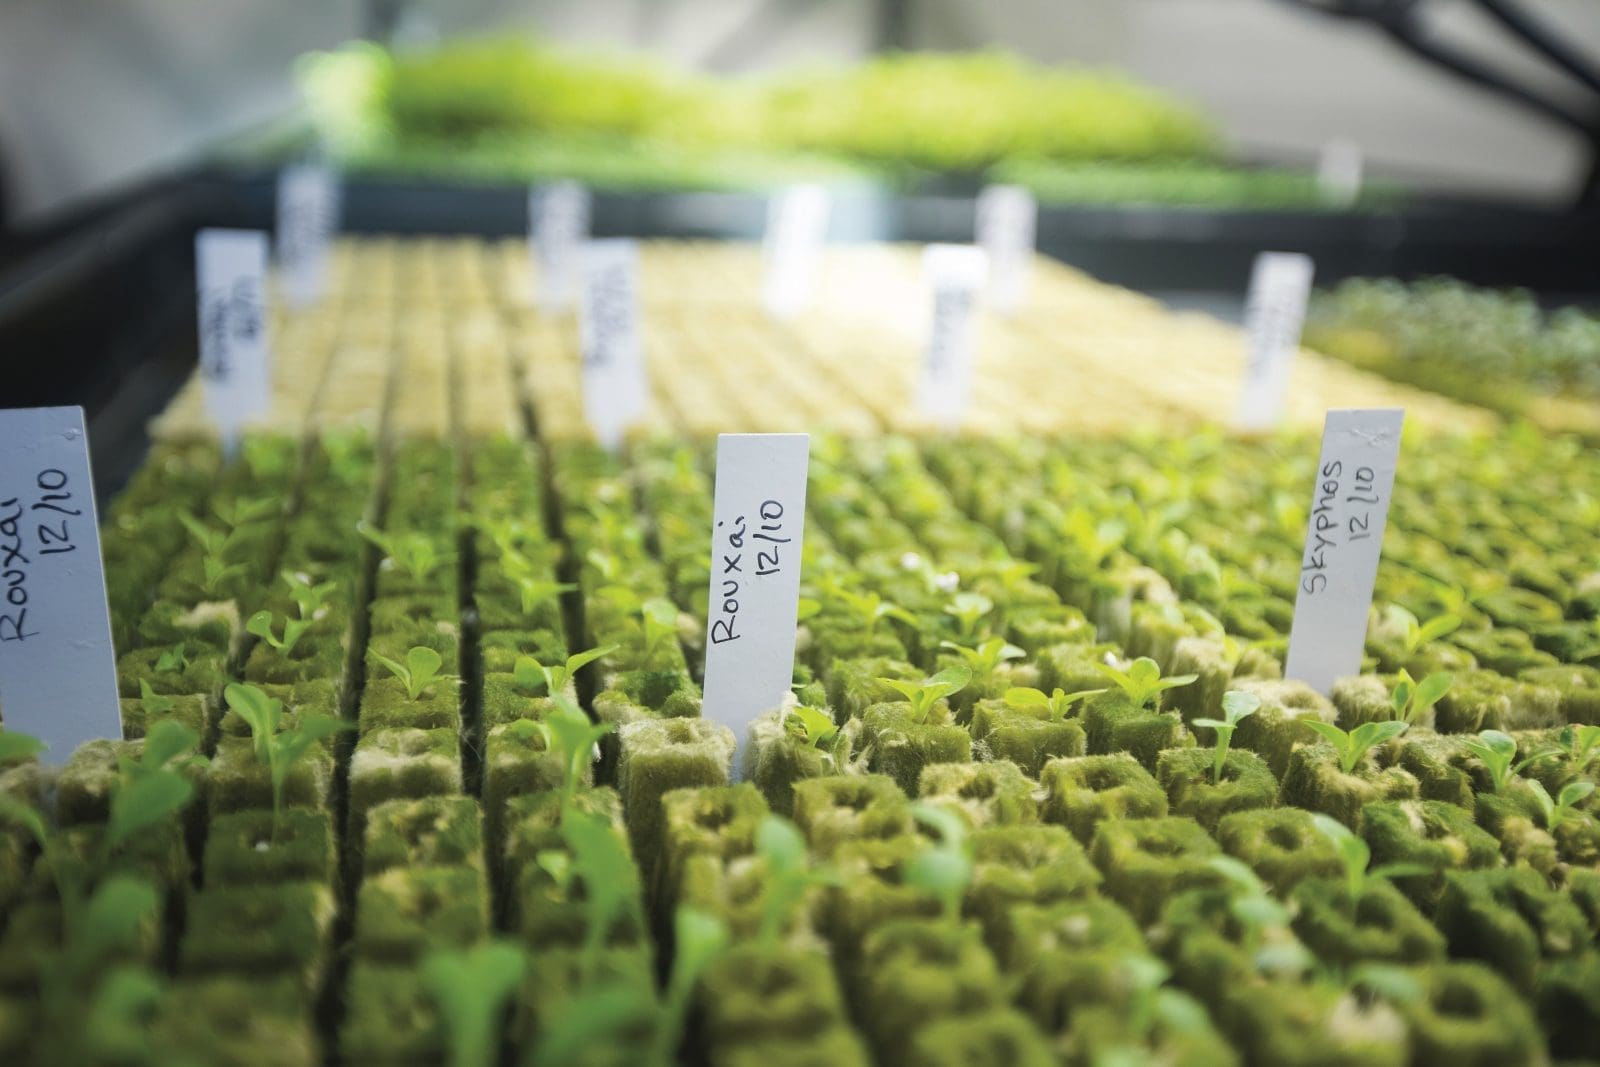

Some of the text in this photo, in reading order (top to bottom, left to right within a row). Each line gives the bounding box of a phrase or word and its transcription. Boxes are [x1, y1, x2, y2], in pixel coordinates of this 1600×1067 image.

[31, 468, 82, 555] 12/10
[752, 500, 792, 576] 12/10
[1346, 466, 1380, 542] 12/10
[711, 516, 746, 644] Rouxai
